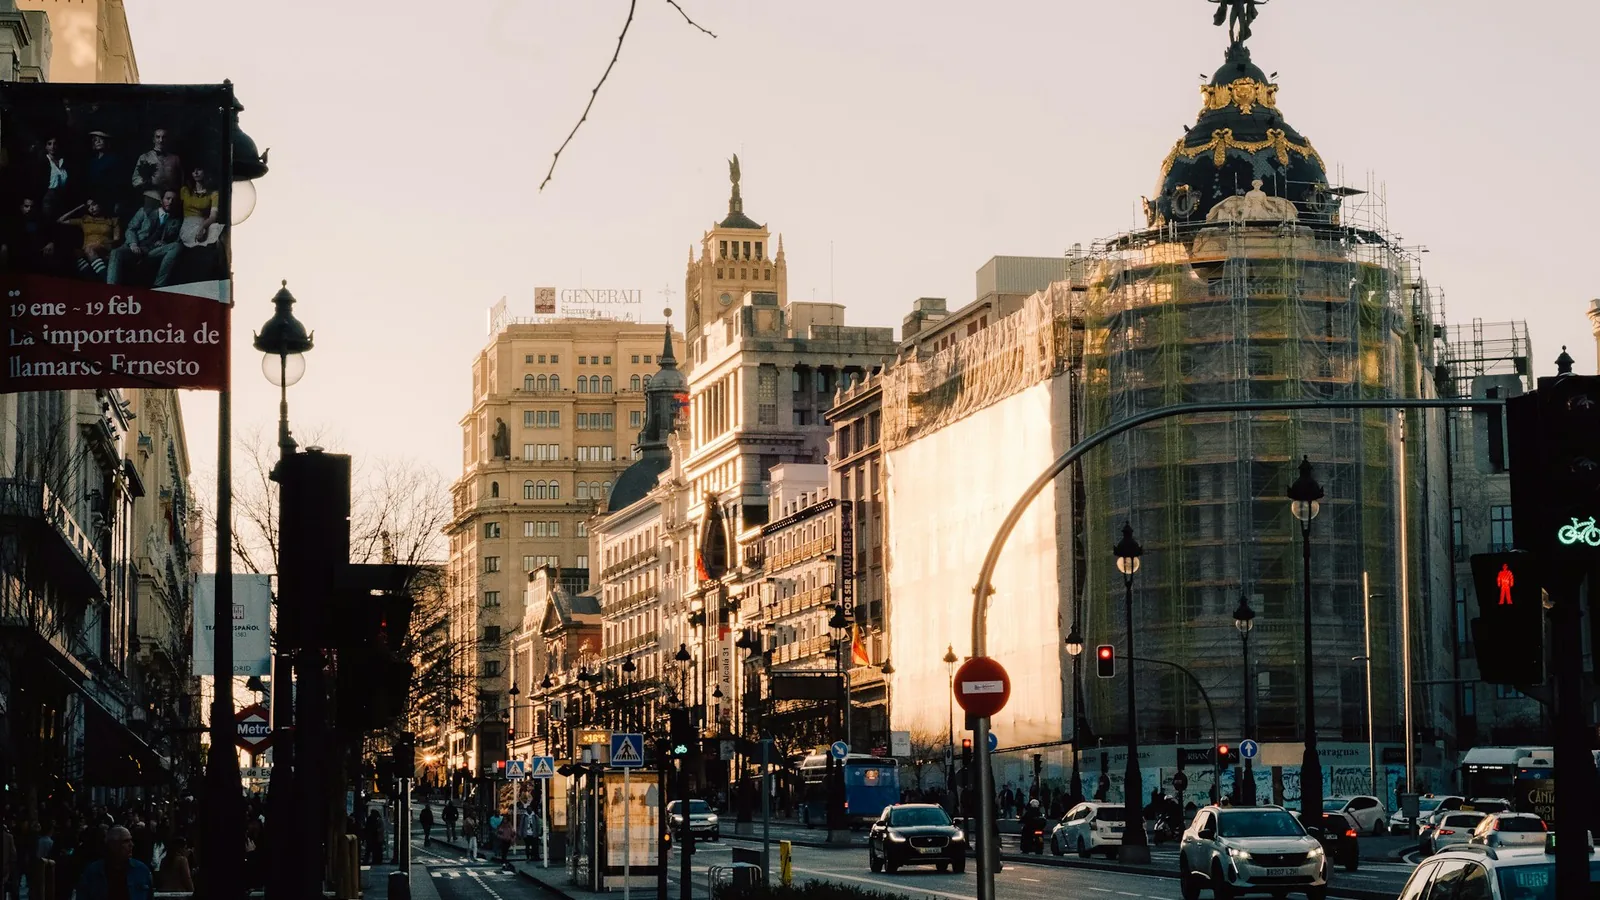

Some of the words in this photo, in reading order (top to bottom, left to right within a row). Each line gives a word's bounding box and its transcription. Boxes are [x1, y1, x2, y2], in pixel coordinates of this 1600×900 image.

[561, 288, 642, 304] GENERALI
[9, 303, 26, 317] 19
[30, 302, 66, 316] ene
[86, 302, 104, 316] 19
[107, 295, 141, 316] feb
[9, 328, 35, 346] La
[42, 322, 186, 351] importancia
[193, 322, 220, 344] de
[109, 354, 200, 376] Ernesto
[843, 530, 852, 578] MUJERES
[844, 579, 852, 596] SER
[844, 597, 852, 616] POR
[232, 623, 260, 631] SPAÑOL
[722, 647, 730, 655] 31
[722, 658, 730, 684] Alcalá
[237, 723, 272, 735] Metro
[246, 768, 256, 777] de
